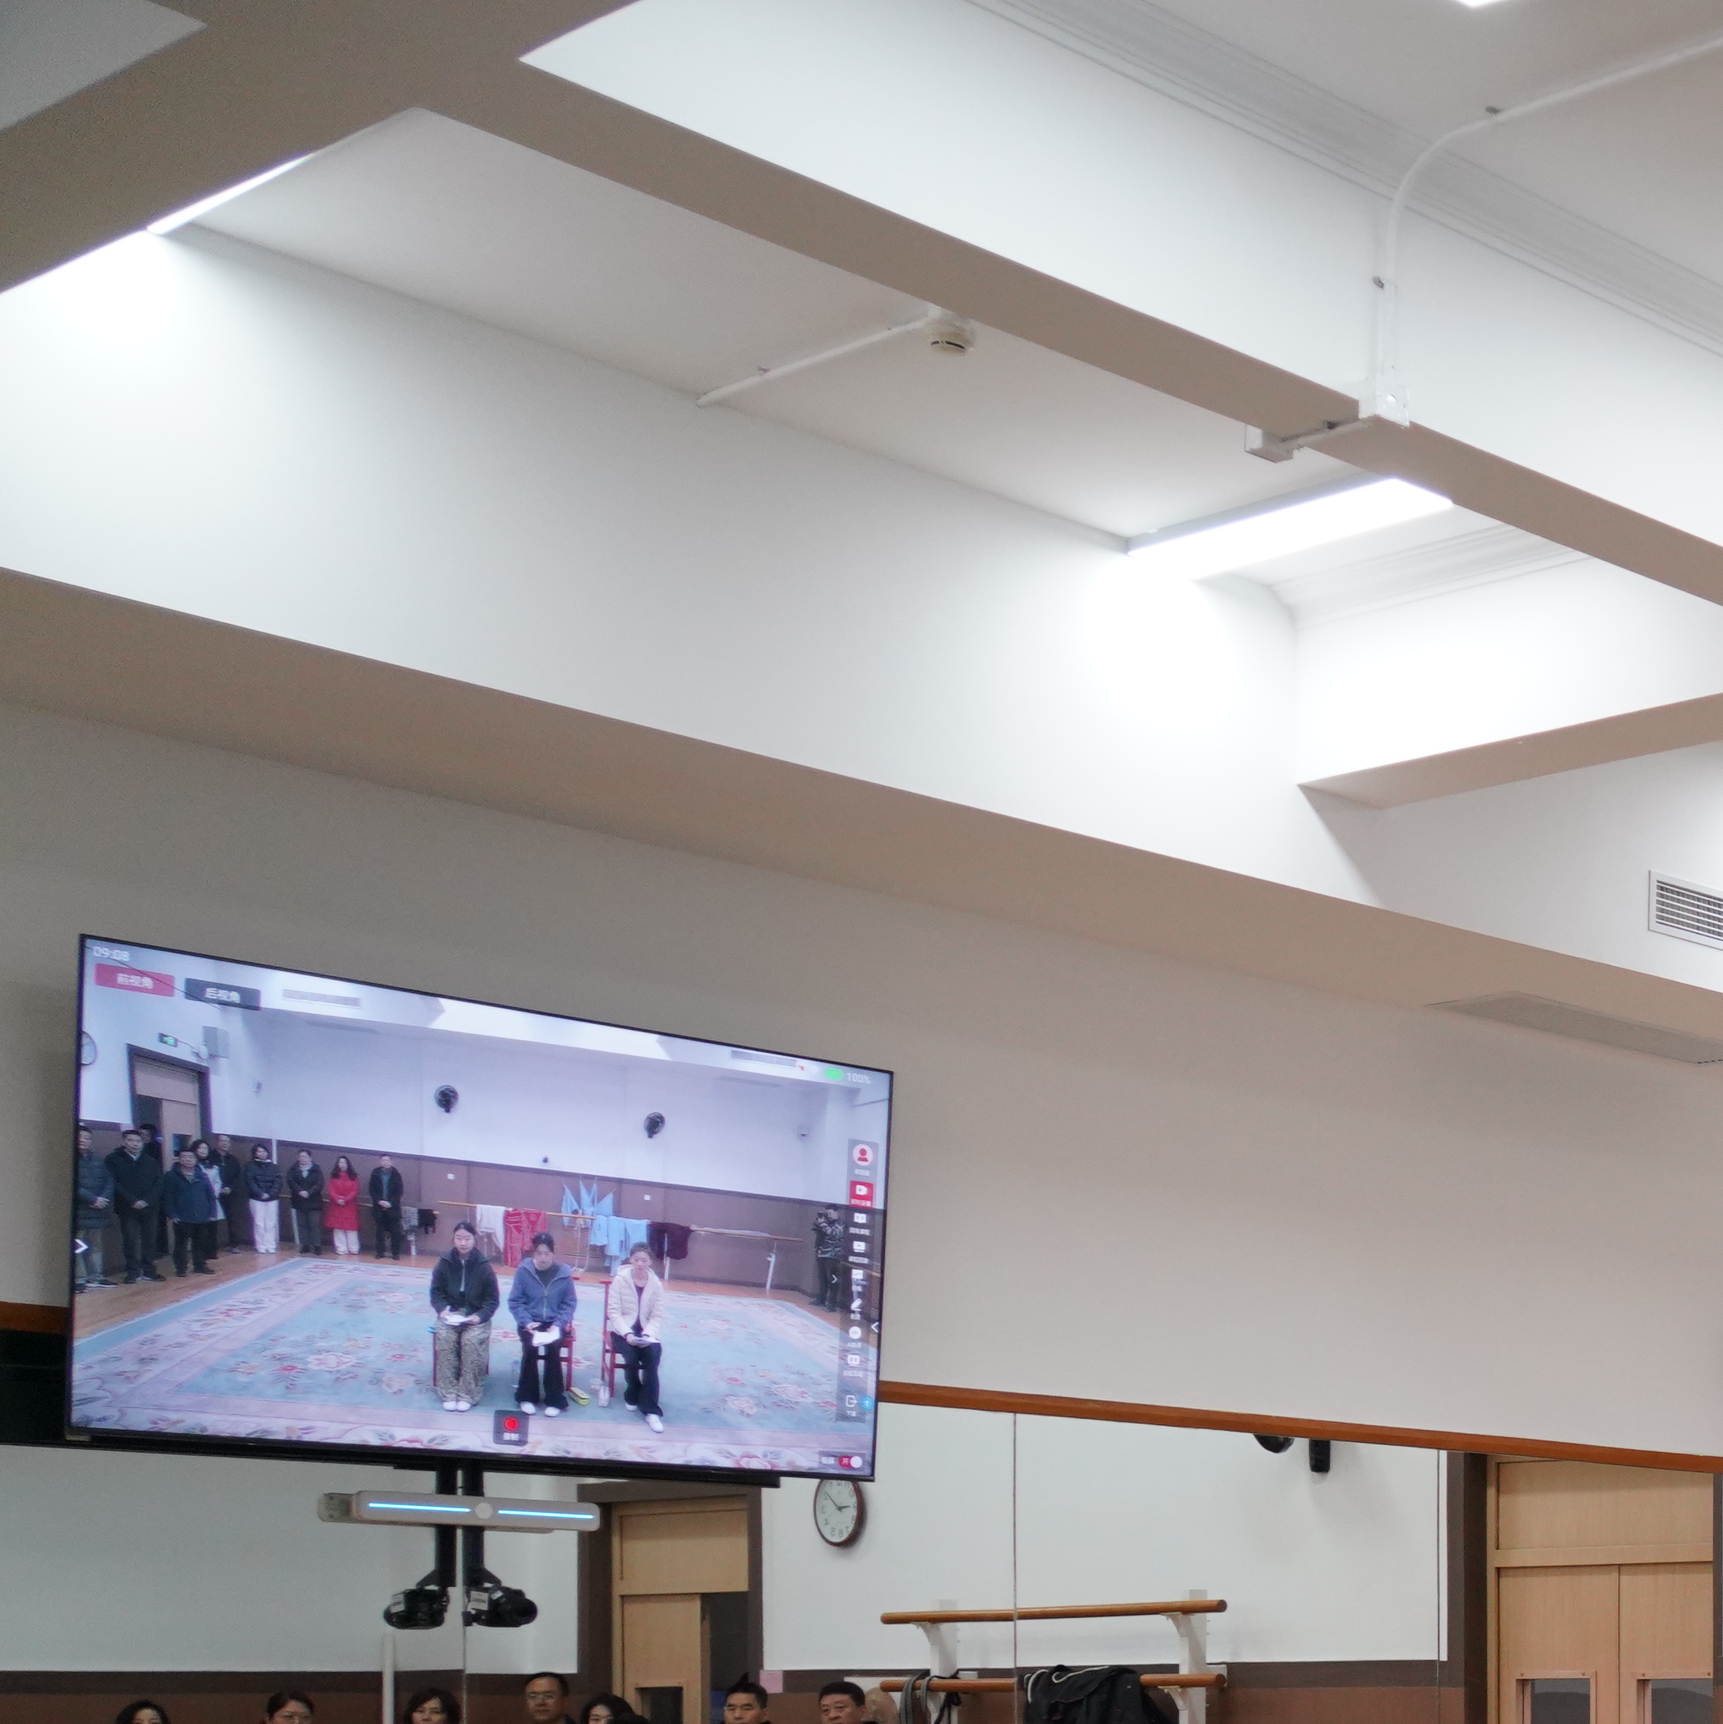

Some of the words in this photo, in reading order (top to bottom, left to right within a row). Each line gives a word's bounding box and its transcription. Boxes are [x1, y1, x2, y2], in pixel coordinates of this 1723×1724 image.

[93, 946, 130, 962] 09:08
[205, 987, 241, 1004] 后视角
[847, 1072, 871, 1084] 100%
